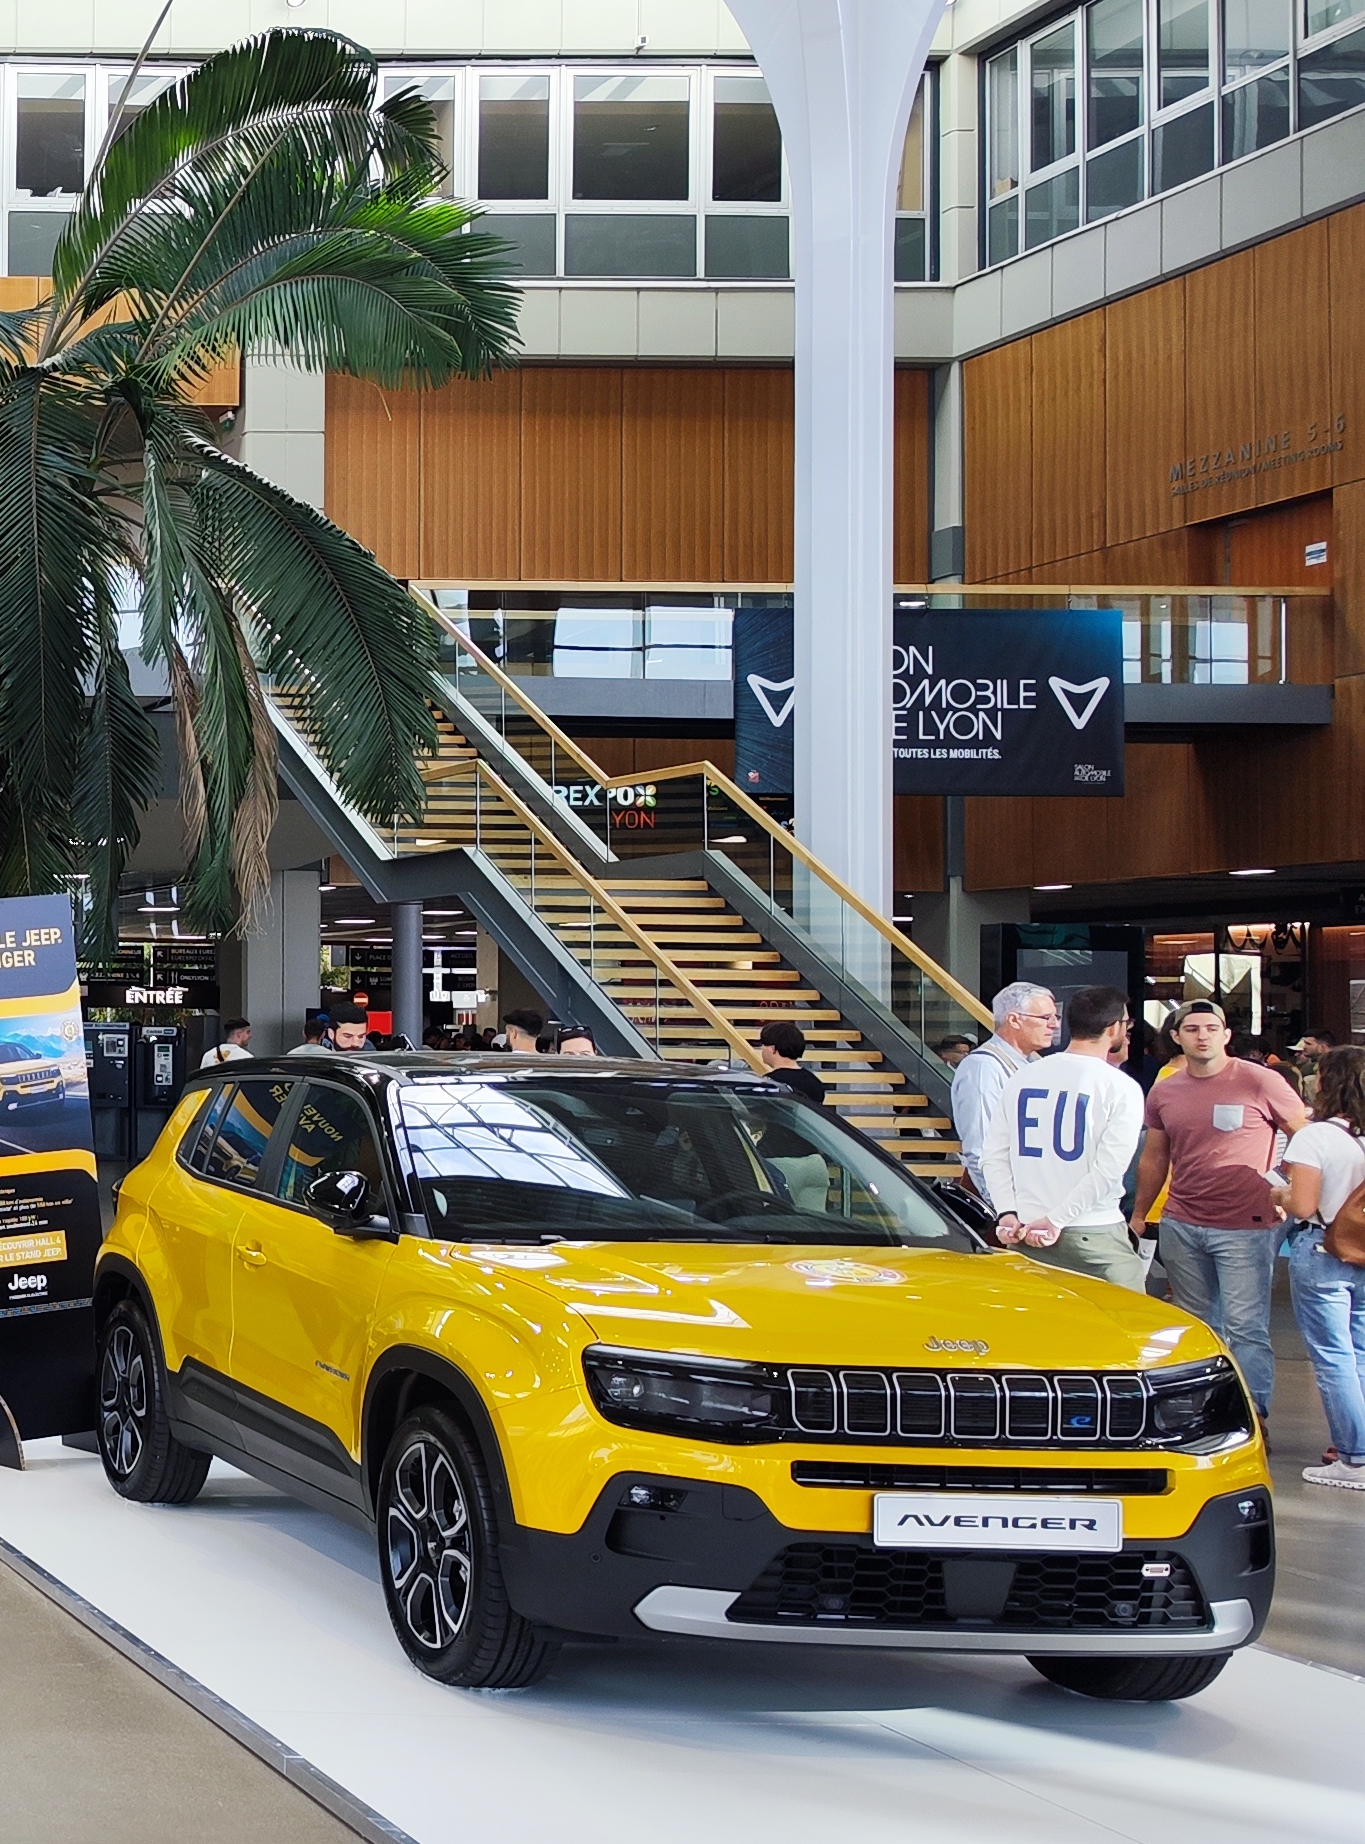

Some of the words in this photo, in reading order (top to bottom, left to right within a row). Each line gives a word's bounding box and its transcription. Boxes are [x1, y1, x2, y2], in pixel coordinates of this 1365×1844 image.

[1170, 431, 1291, 483] MEZZANINE
[1172, 482, 1199, 497] SALLES
[1201, 477, 1214, 488] DE
[1306, 440, 1344, 458] ROOMS
[919, 710, 1002, 741] LYON
[893, 748, 929, 759] TOUTES
[931, 748, 947, 759] LES
[950, 746, 1002, 760] MOBILITÉS.
[612, 811, 656, 829] YON
[125, 987, 184, 1004] ENTRÉE
[1018, 1088, 1091, 1162] EU
[35, 1237, 56, 1247] HALL
[4, 1253, 15, 1262] LE
[16, 1250, 41, 1261] STAND
[8, 1274, 47, 1291] Jeep
[922, 1335, 990, 1356] Jeep
[897, 1513, 1098, 1531] AVENGER
